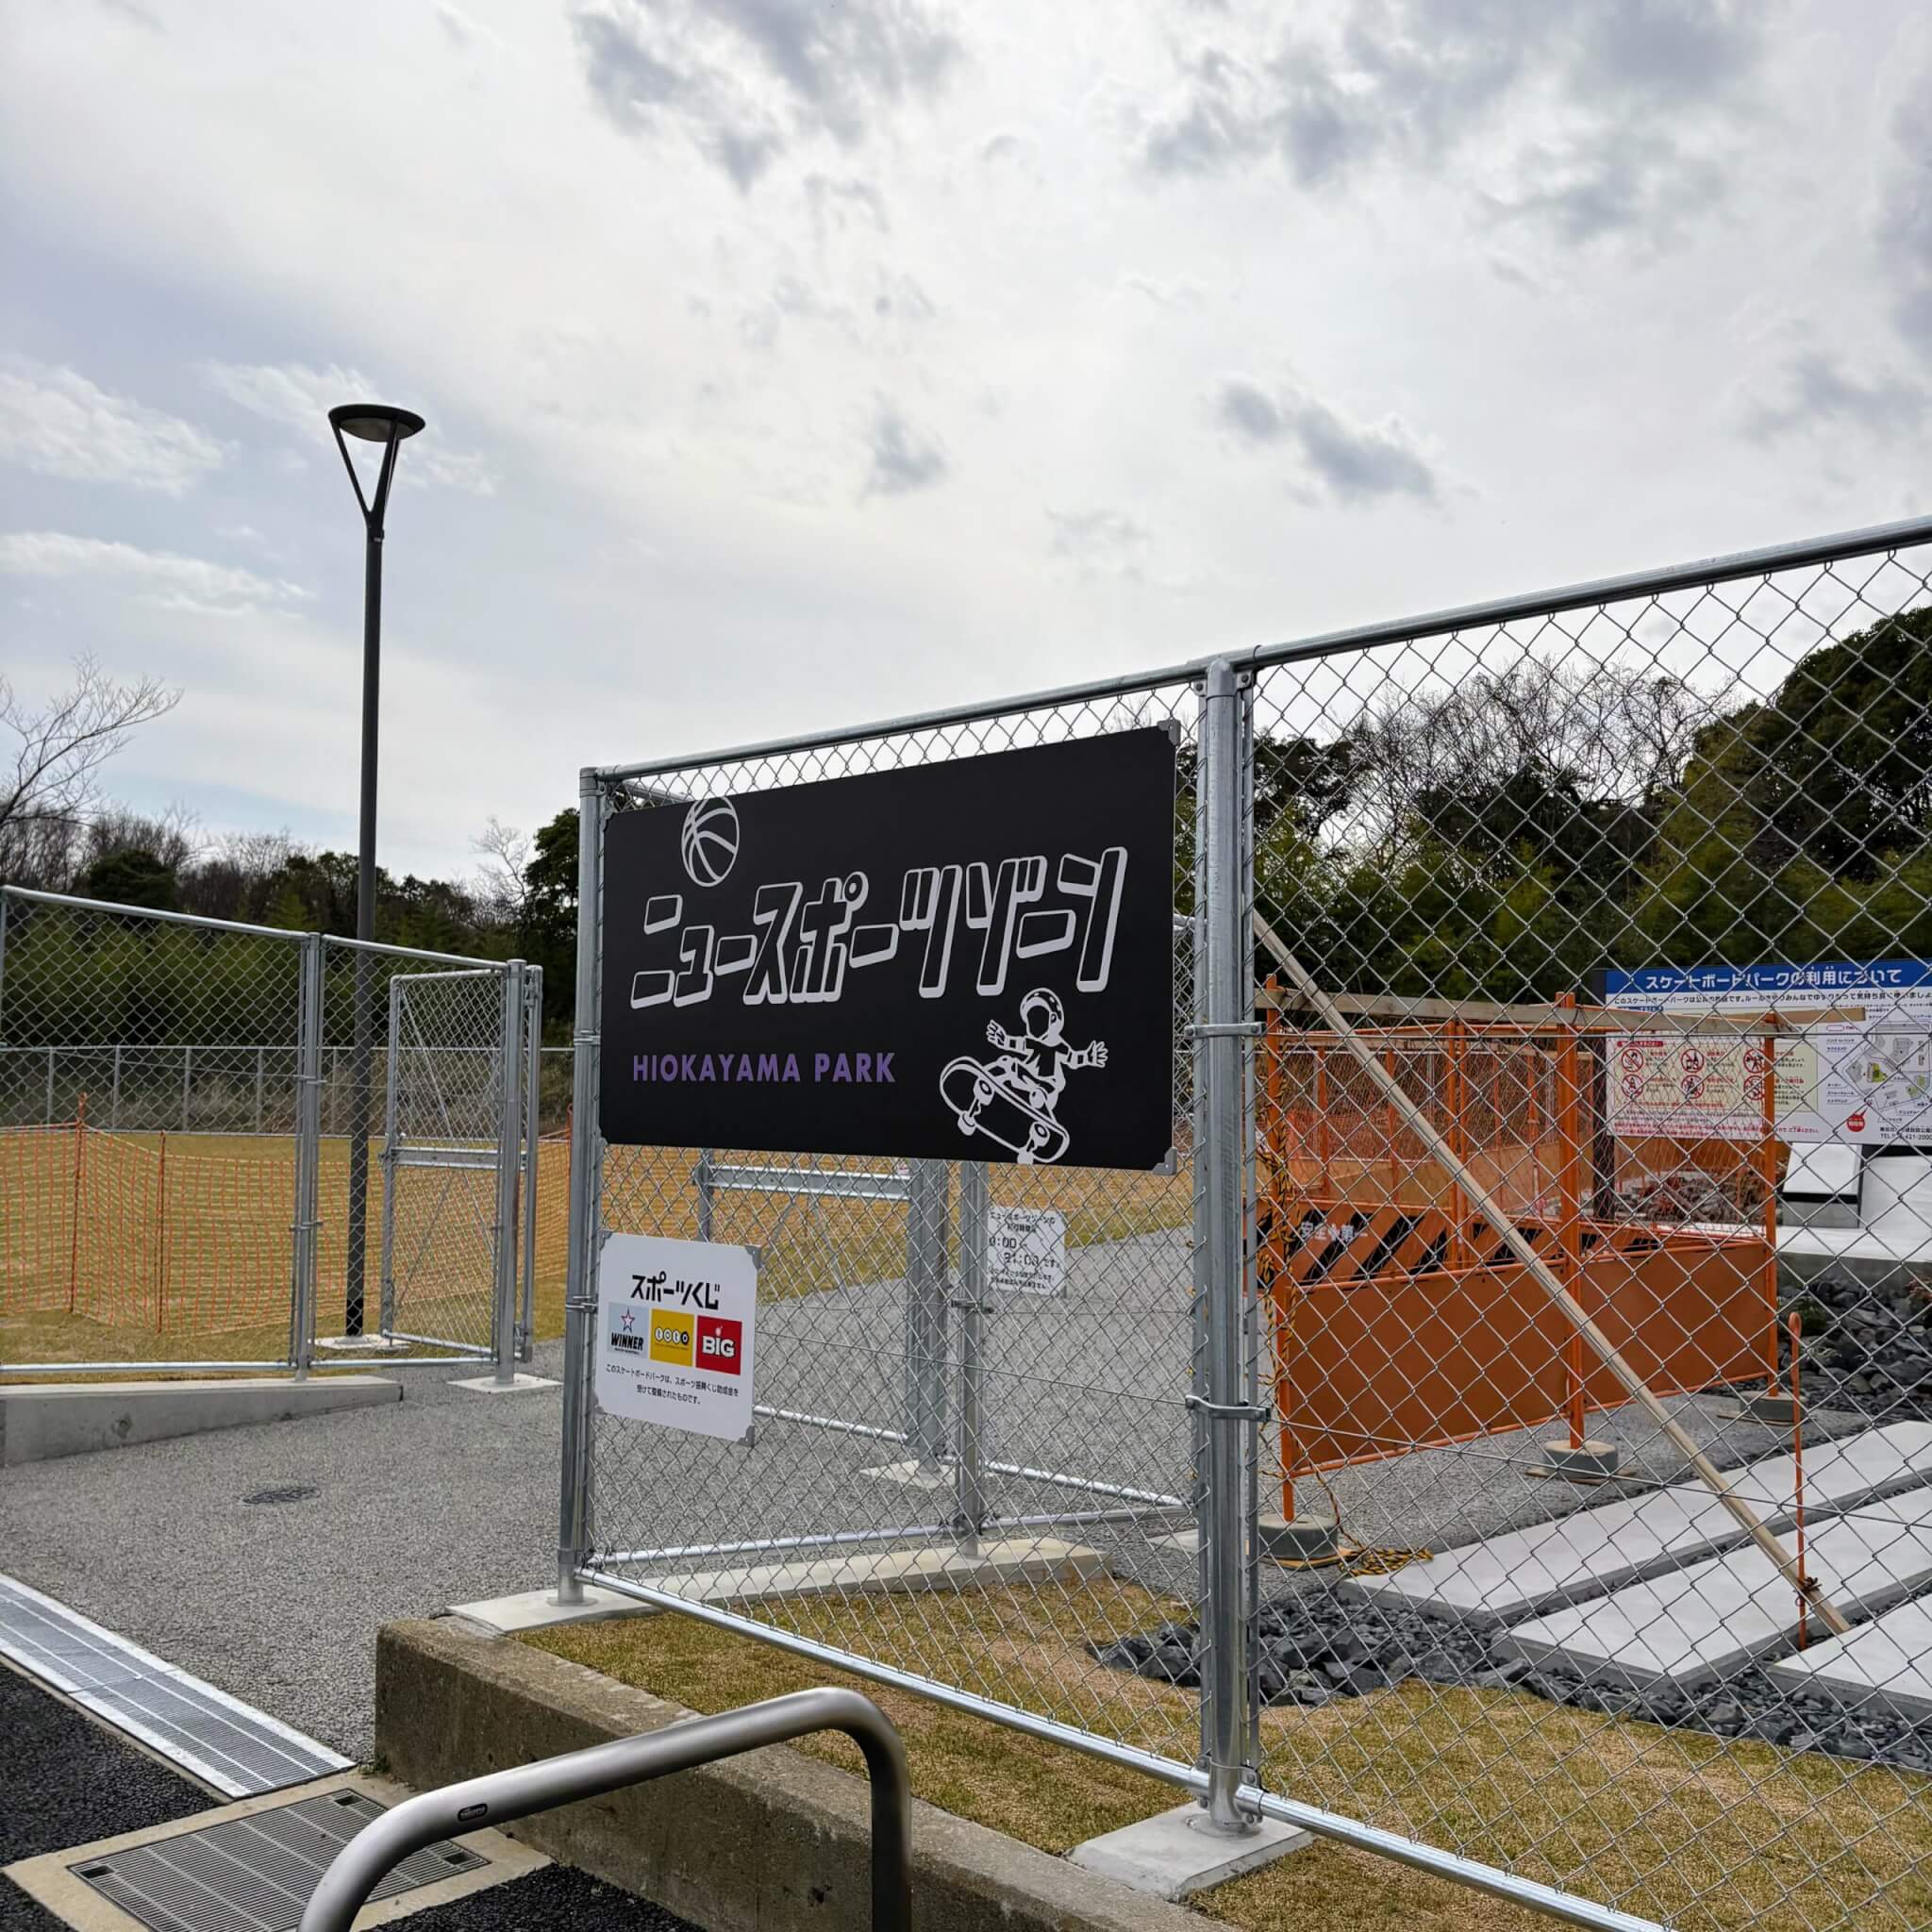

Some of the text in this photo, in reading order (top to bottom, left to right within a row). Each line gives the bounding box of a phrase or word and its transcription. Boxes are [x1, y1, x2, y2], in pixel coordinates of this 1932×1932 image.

[630, 846, 1127, 1009] ニュースポーツゾーン
[1646, 970, 1902, 989] スケートボードパークの利用について
[633, 1052, 895, 1083] HIOKAYAMA PARK
[630, 1270, 721, 1310] スポーツくじ
[611, 1332, 643, 1351] WINNER
[655, 1325, 690, 1345] toto
[702, 1335, 736, 1357] BIG
